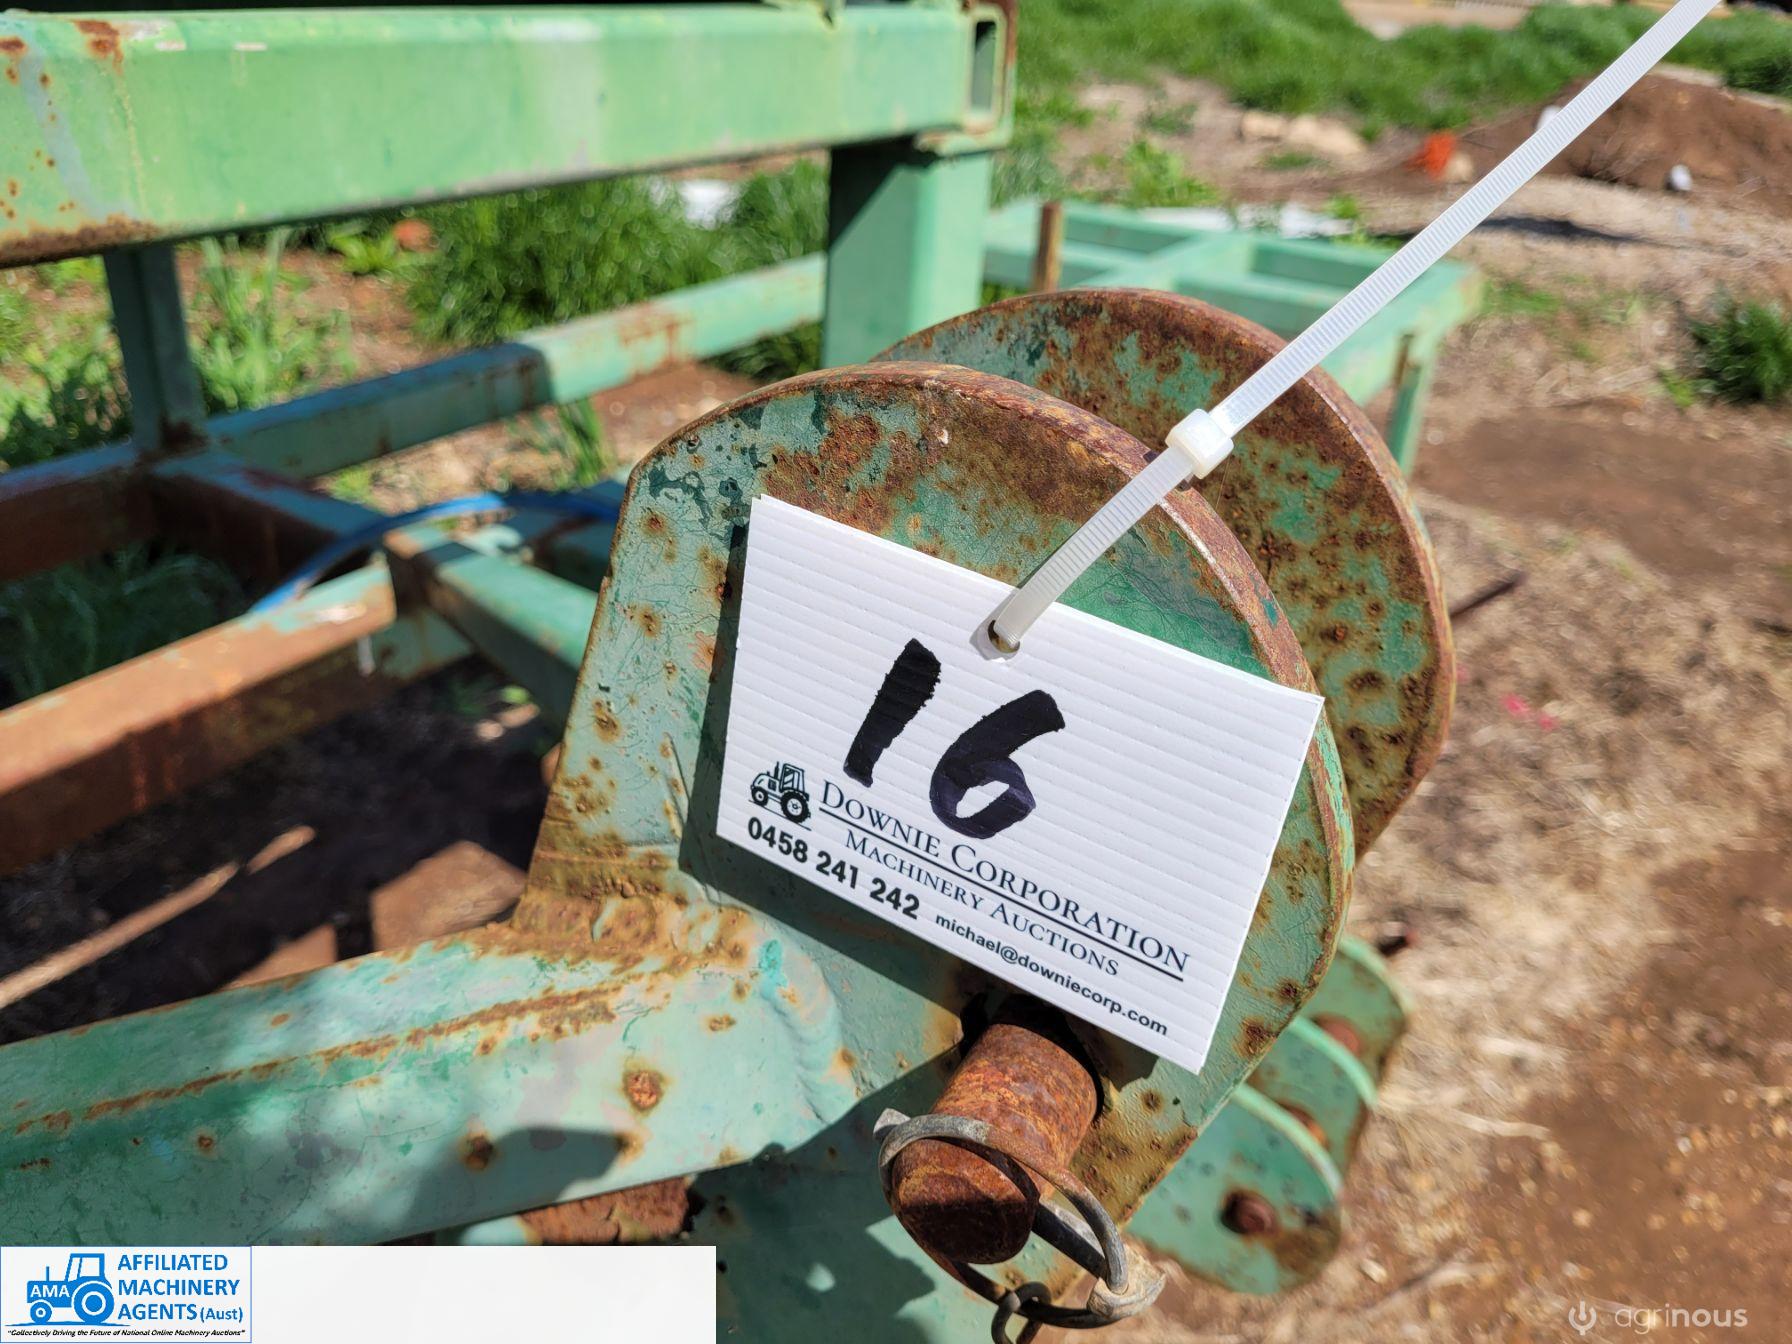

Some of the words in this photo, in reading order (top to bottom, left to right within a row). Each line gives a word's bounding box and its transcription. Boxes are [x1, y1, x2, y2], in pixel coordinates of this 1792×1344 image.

[844, 637, 1066, 840] 16
[747, 816, 808, 864] 0458
[815, 849, 859, 889] 241
[869, 876, 920, 920] 242
[935, 913, 1168, 1036] michael@downiecorp.com
[823, 779, 941, 858] DOWNIE
[950, 843, 1191, 973] CORPORATION
[845, 828, 985, 911] MACHINERY
[990, 902, 1120, 977] AUCTIONS
